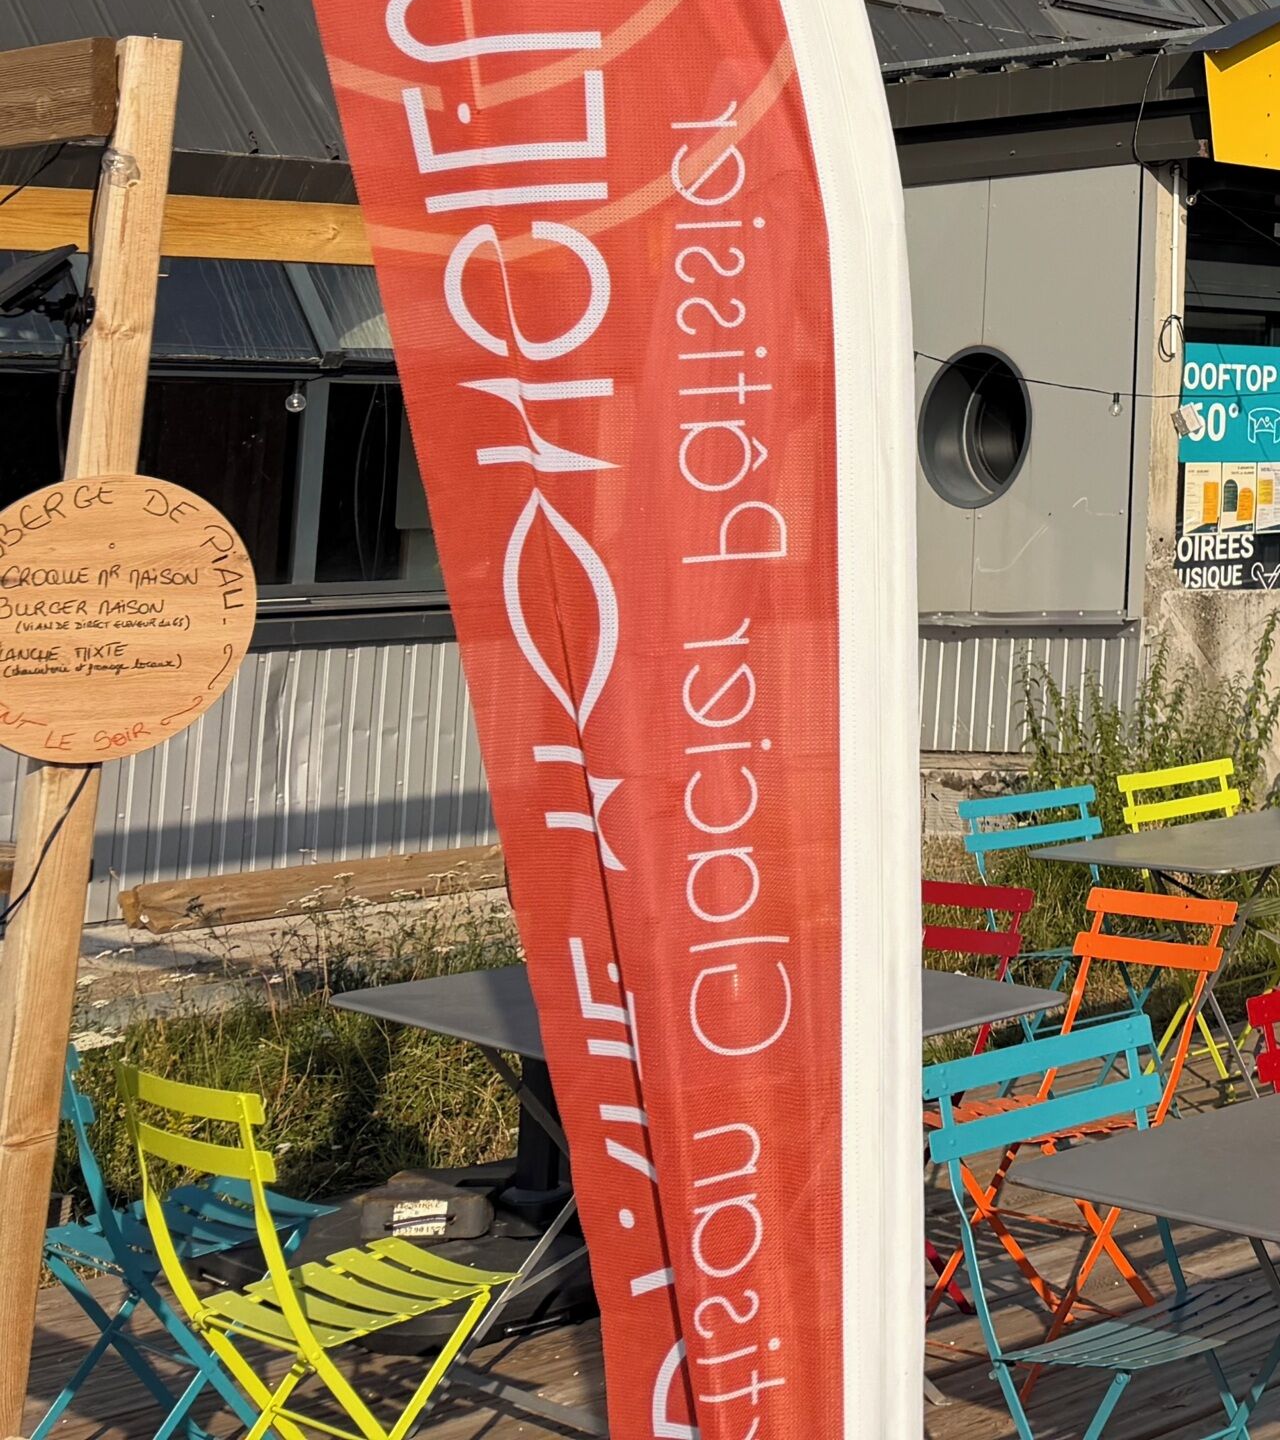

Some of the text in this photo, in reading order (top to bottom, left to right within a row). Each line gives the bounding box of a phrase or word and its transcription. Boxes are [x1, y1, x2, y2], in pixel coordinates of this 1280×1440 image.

[1183, 362, 1278, 393] OOFTOP
[143, 488, 200, 524] DE
[1, 564, 91, 589] CROQUE
[1174, 564, 1243, 589] USIQUE
[0, 596, 89, 620] BURGER
[44, 730, 77, 751] LE
